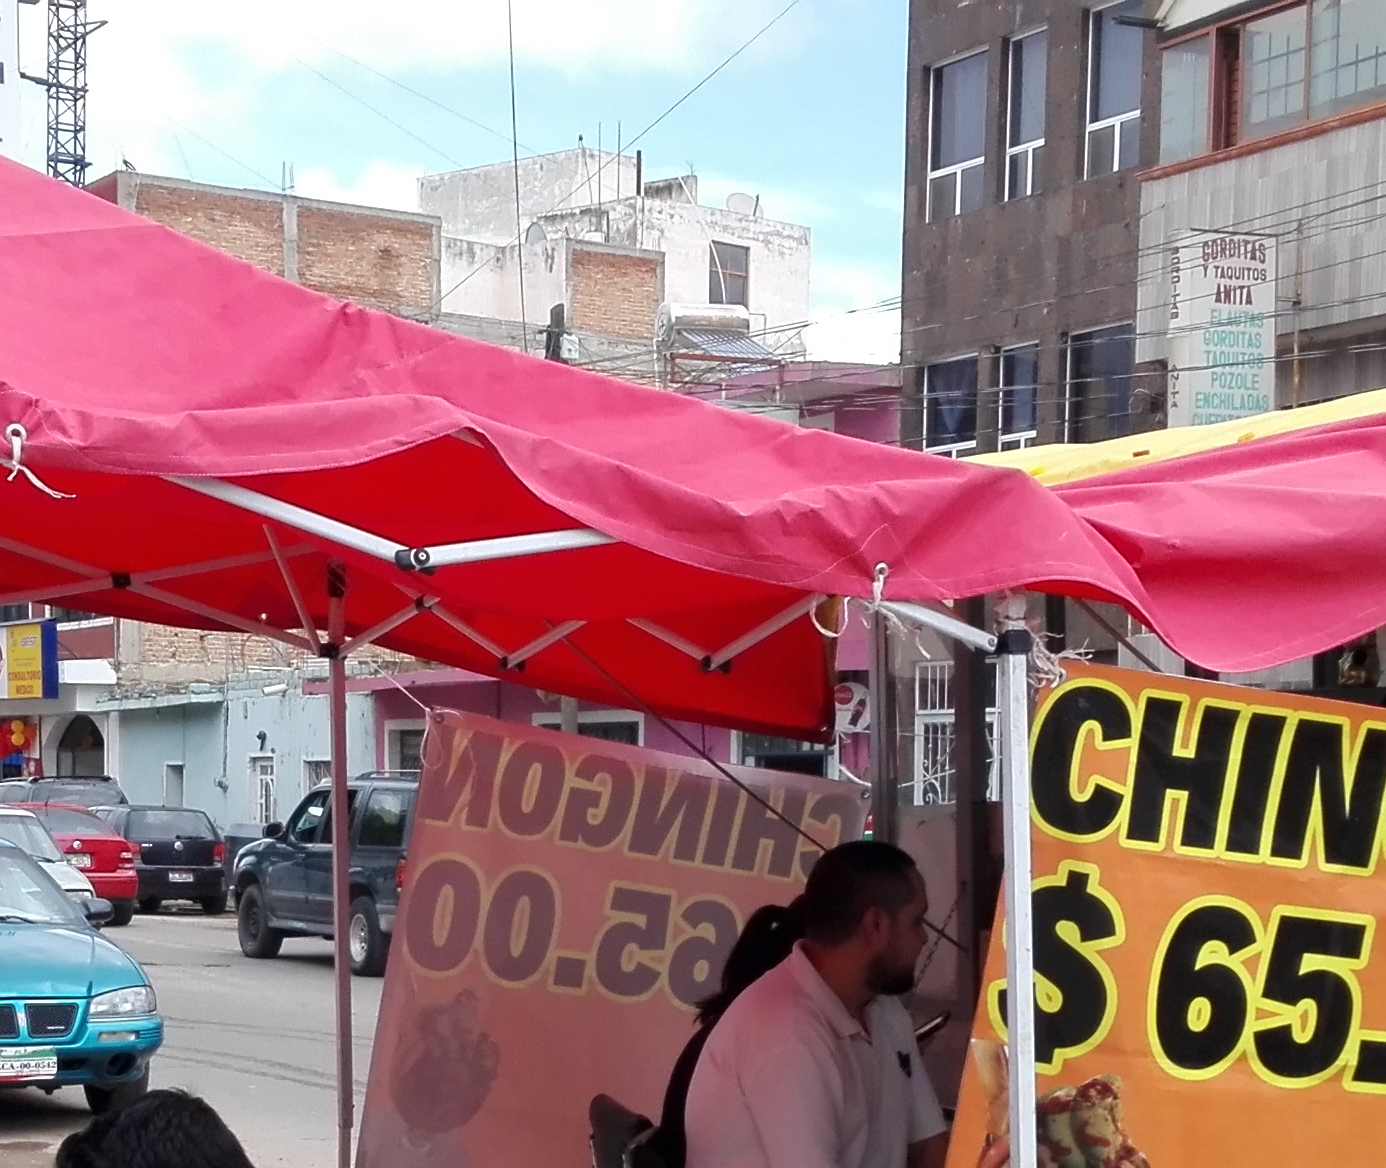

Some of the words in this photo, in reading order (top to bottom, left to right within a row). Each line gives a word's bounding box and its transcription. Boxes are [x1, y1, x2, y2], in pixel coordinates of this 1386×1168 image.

[1202, 238, 1266, 264] GORDITAS
[1202, 264, 1209, 278] Y
[1214, 265, 1267, 281] TAQUITOS
[1214, 283, 1253, 305] ANITA
[1203, 330, 1262, 349] GORDITAS
[1204, 351, 1264, 369] TAQUITOS
[1170, 364, 1179, 408] ANITA
[1211, 372, 1259, 391] POZOLE
[1195, 392, 1269, 411] ENCHILADAS
